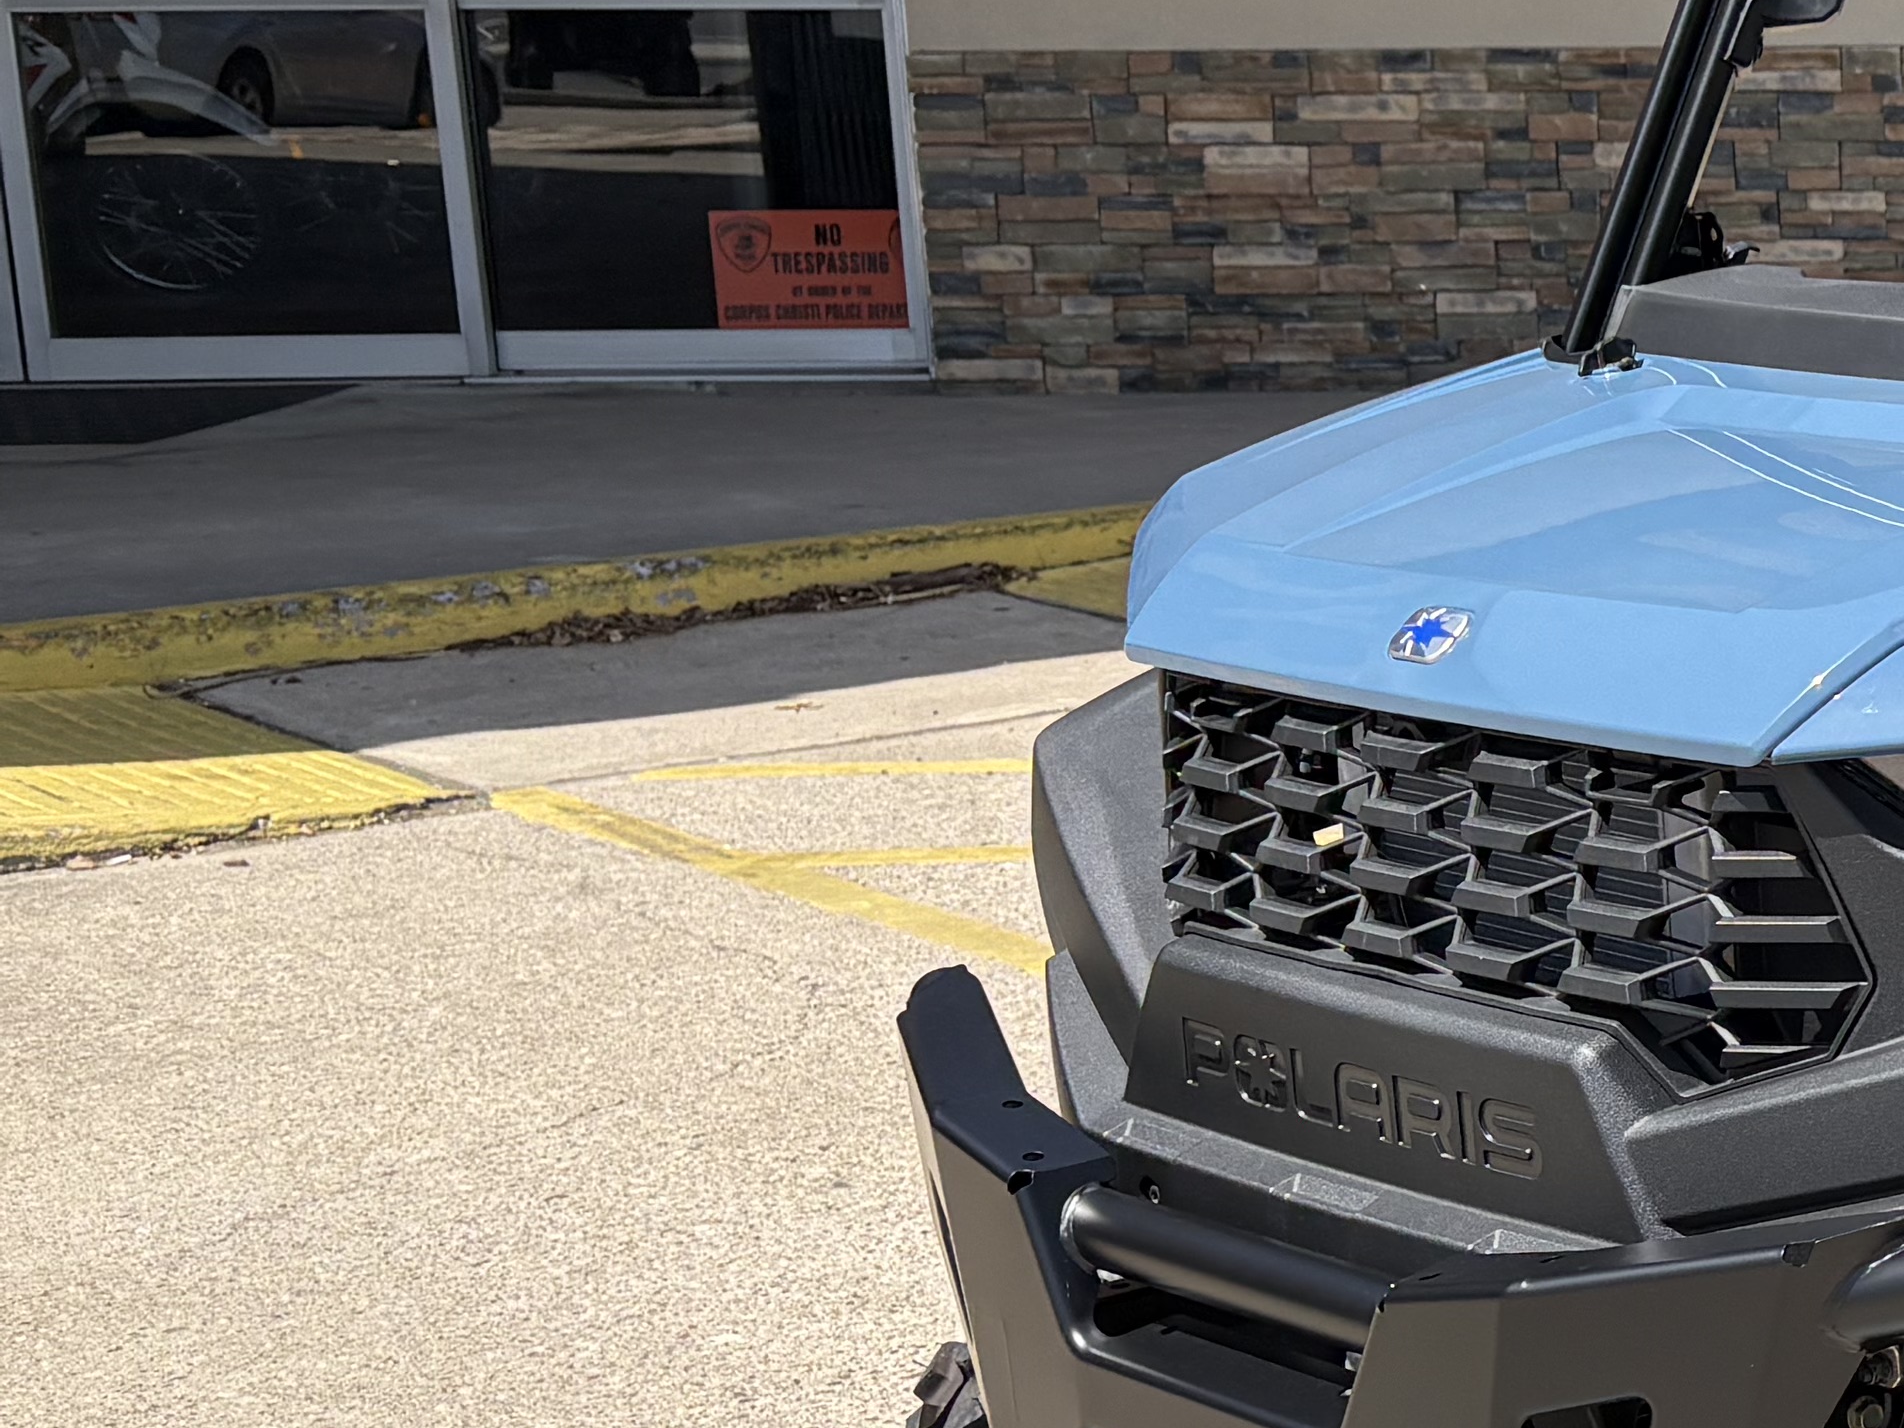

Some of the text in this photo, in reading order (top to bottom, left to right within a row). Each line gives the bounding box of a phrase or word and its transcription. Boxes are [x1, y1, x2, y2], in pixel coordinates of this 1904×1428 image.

[813, 223, 842, 247] NO
[771, 251, 890, 275] TRESPASSING
[1181, 1016, 1544, 1181] POLARIS
